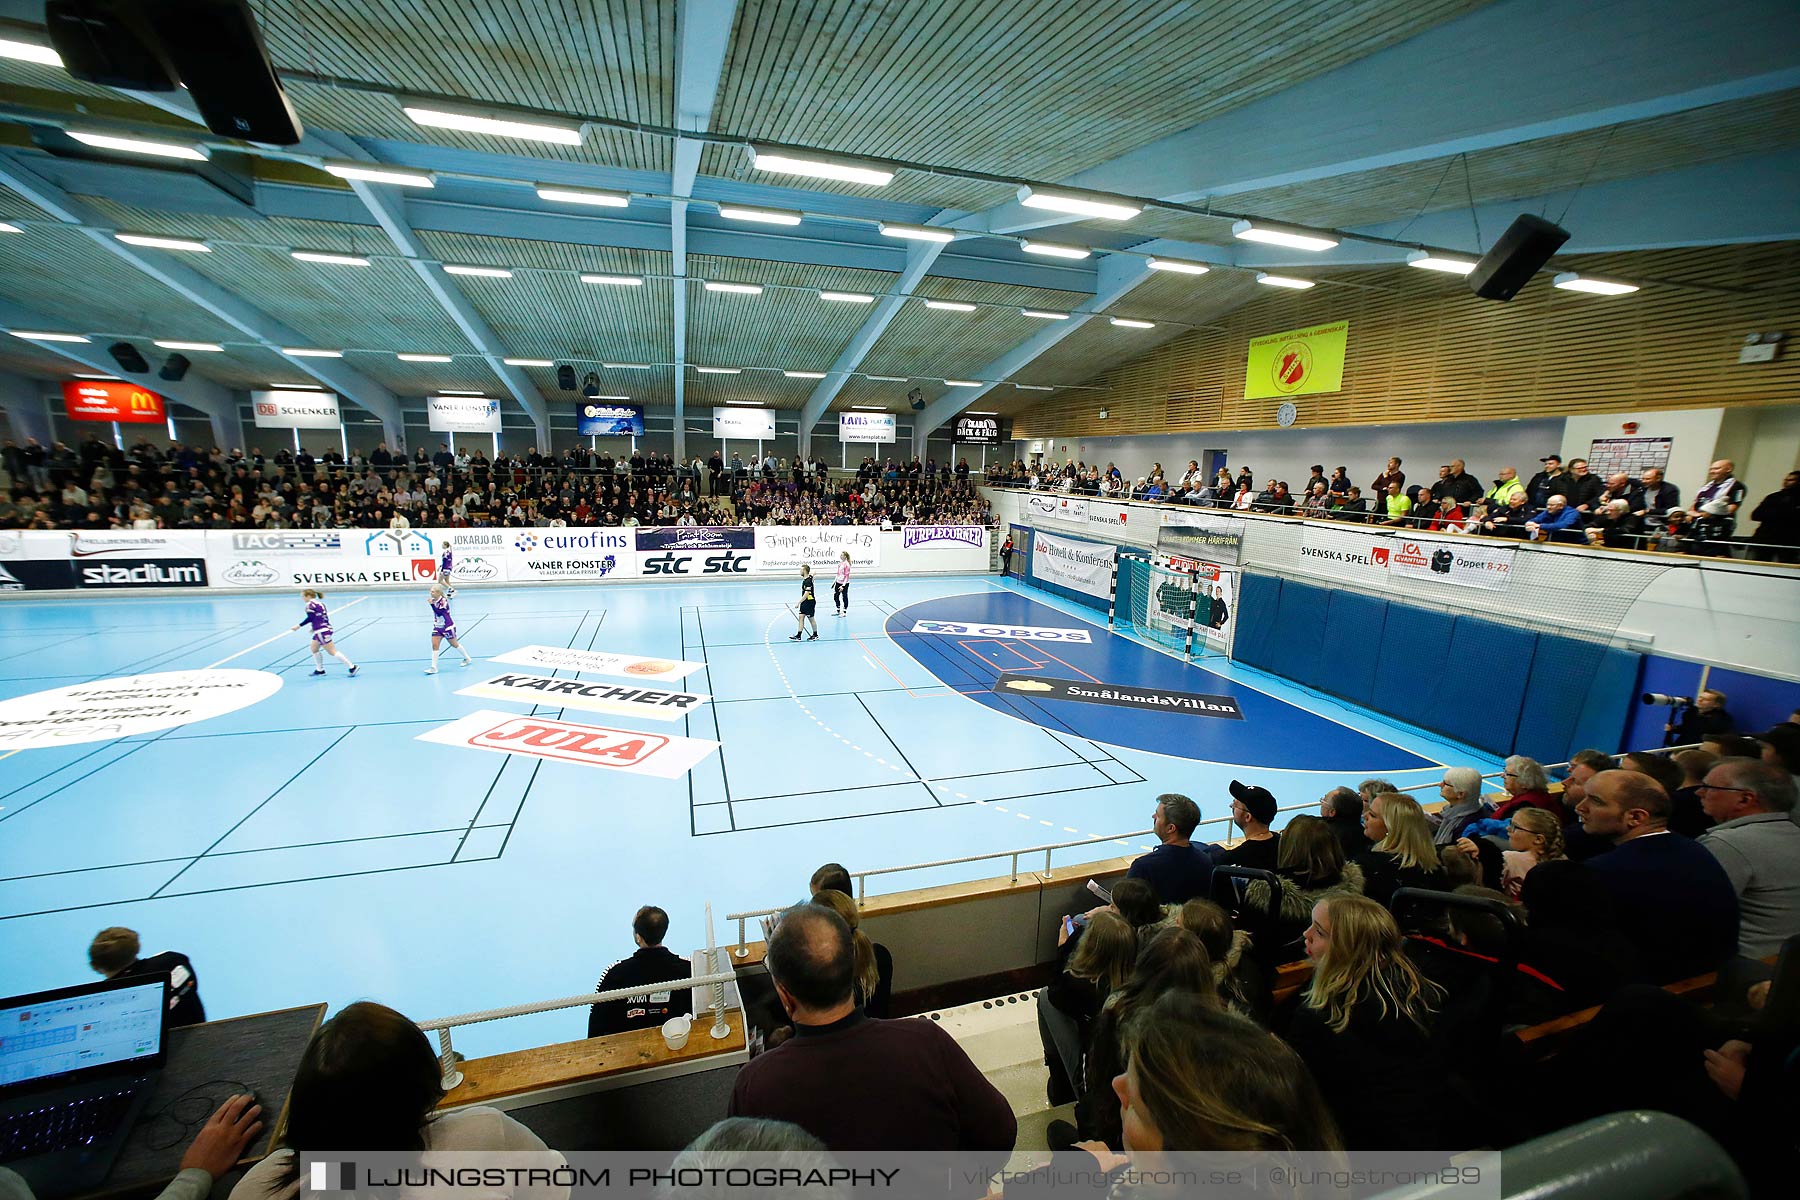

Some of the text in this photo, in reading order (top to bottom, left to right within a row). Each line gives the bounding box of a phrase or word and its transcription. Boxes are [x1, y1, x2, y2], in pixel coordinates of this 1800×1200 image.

[259, 403, 337, 415] DB SCHENKER
[238, 533, 281, 548] IAC
[491, 535, 503, 544] AB
[544, 531, 627, 548] eurofins
[1048, 544, 1067, 559] Hotell
[1067, 549, 1074, 561] &
[1075, 550, 1113, 570] Konferens
[1301, 546, 1369, 565] SVENSKA SPEL
[1402, 543, 1422, 556] ICA
[642, 550, 752, 575] stc stc
[1395, 555, 1427, 565] KVANTUM
[1487, 562, 1510, 573] 8-22
[83, 563, 202, 583] stadium
[293, 571, 411, 584] SVENSKA SPEL
[979, 626, 1089, 642] OBOS
[488, 674, 699, 708] KÄRCHER
[1067, 685, 1237, 713] SmålandsVillan
[485, 725, 646, 761] JULA
